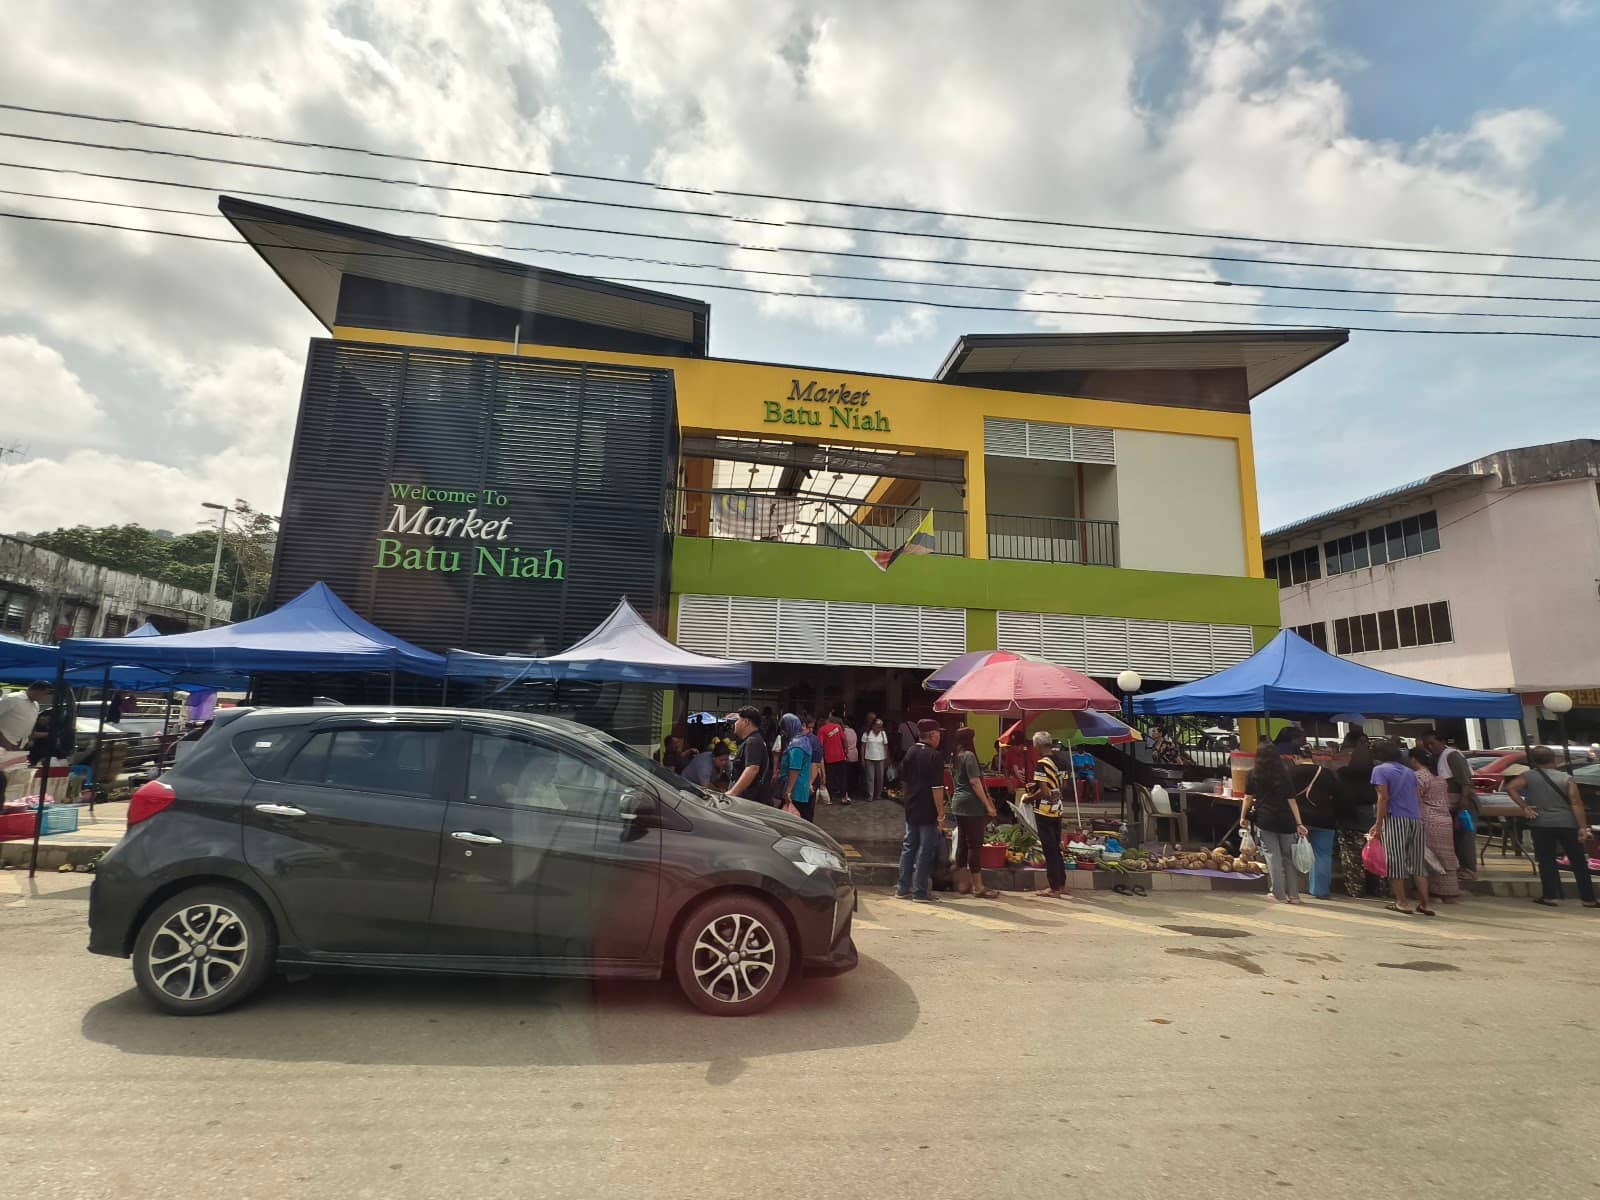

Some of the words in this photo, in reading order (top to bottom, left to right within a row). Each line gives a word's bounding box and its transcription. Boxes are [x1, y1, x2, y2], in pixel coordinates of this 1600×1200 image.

[787, 379, 870, 406] Market
[763, 400, 822, 426] Batu
[829, 405, 891, 432] Niah
[389, 482, 476, 504] Welcome
[482, 489, 508, 506] To
[383, 503, 513, 541] Market
[373, 537, 462, 573] Batu
[473, 546, 565, 580] Niah
